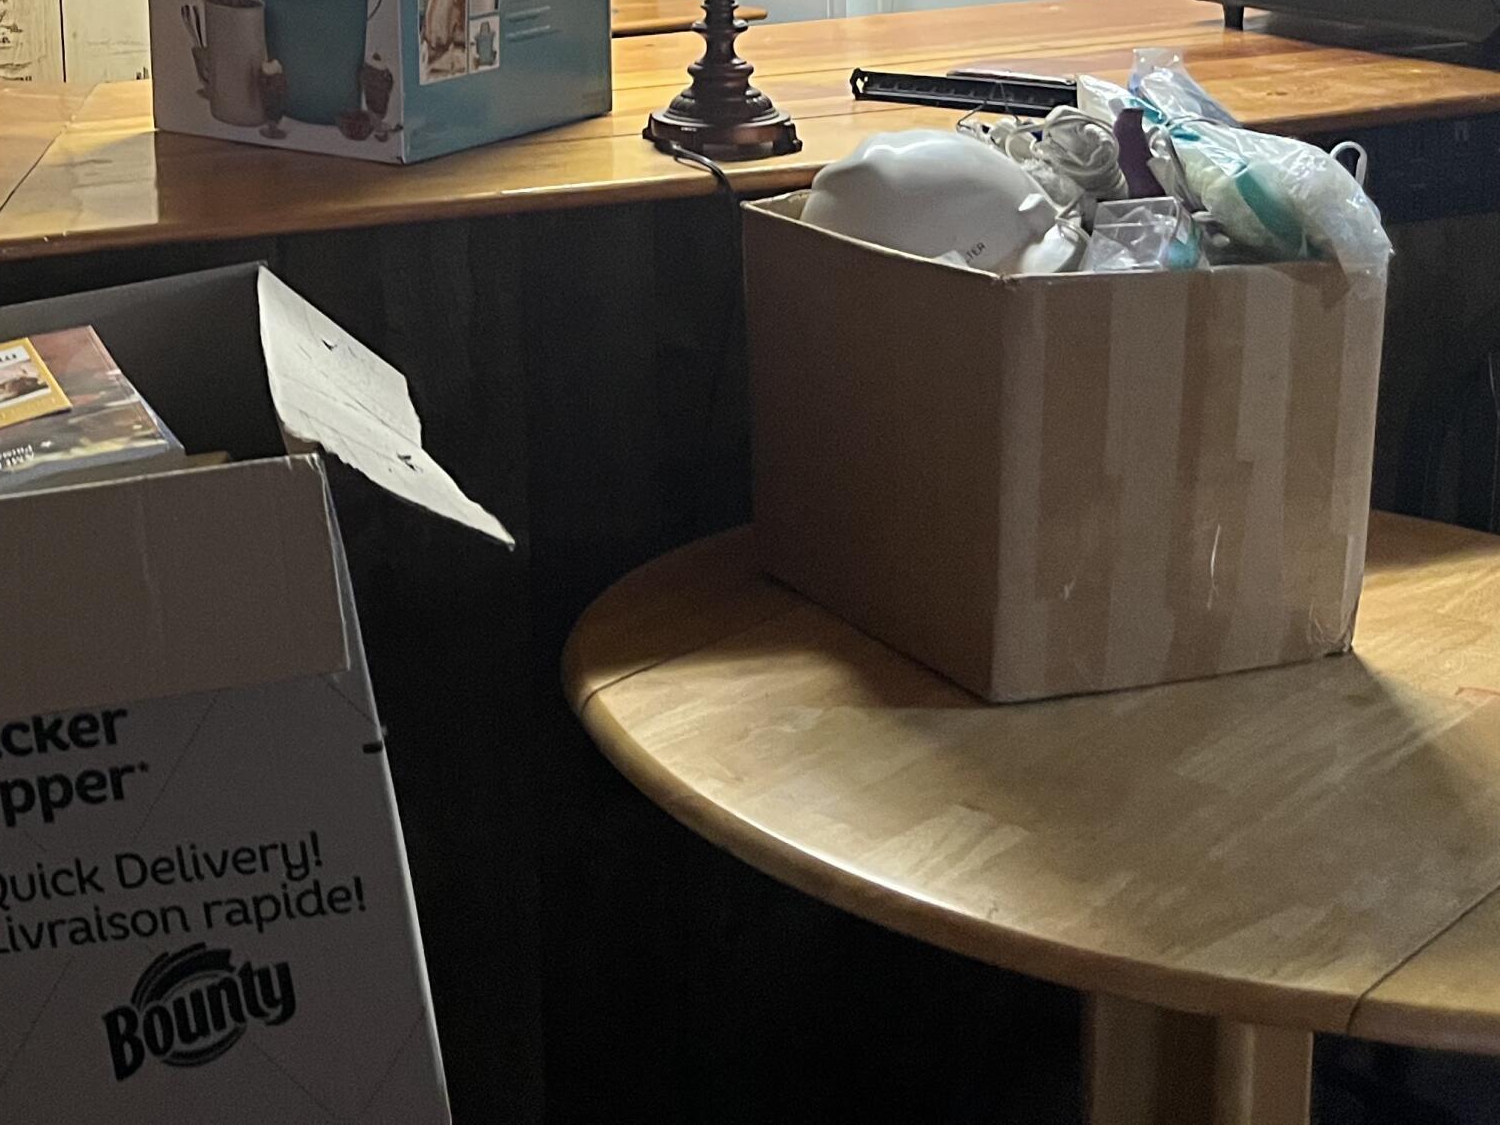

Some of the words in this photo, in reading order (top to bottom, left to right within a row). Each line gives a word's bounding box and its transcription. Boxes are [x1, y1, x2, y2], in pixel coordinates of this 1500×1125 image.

[115, 830, 324, 889] Delivery!
[203, 876, 367, 934] rapide!
[102, 960, 297, 1082] Bounty
